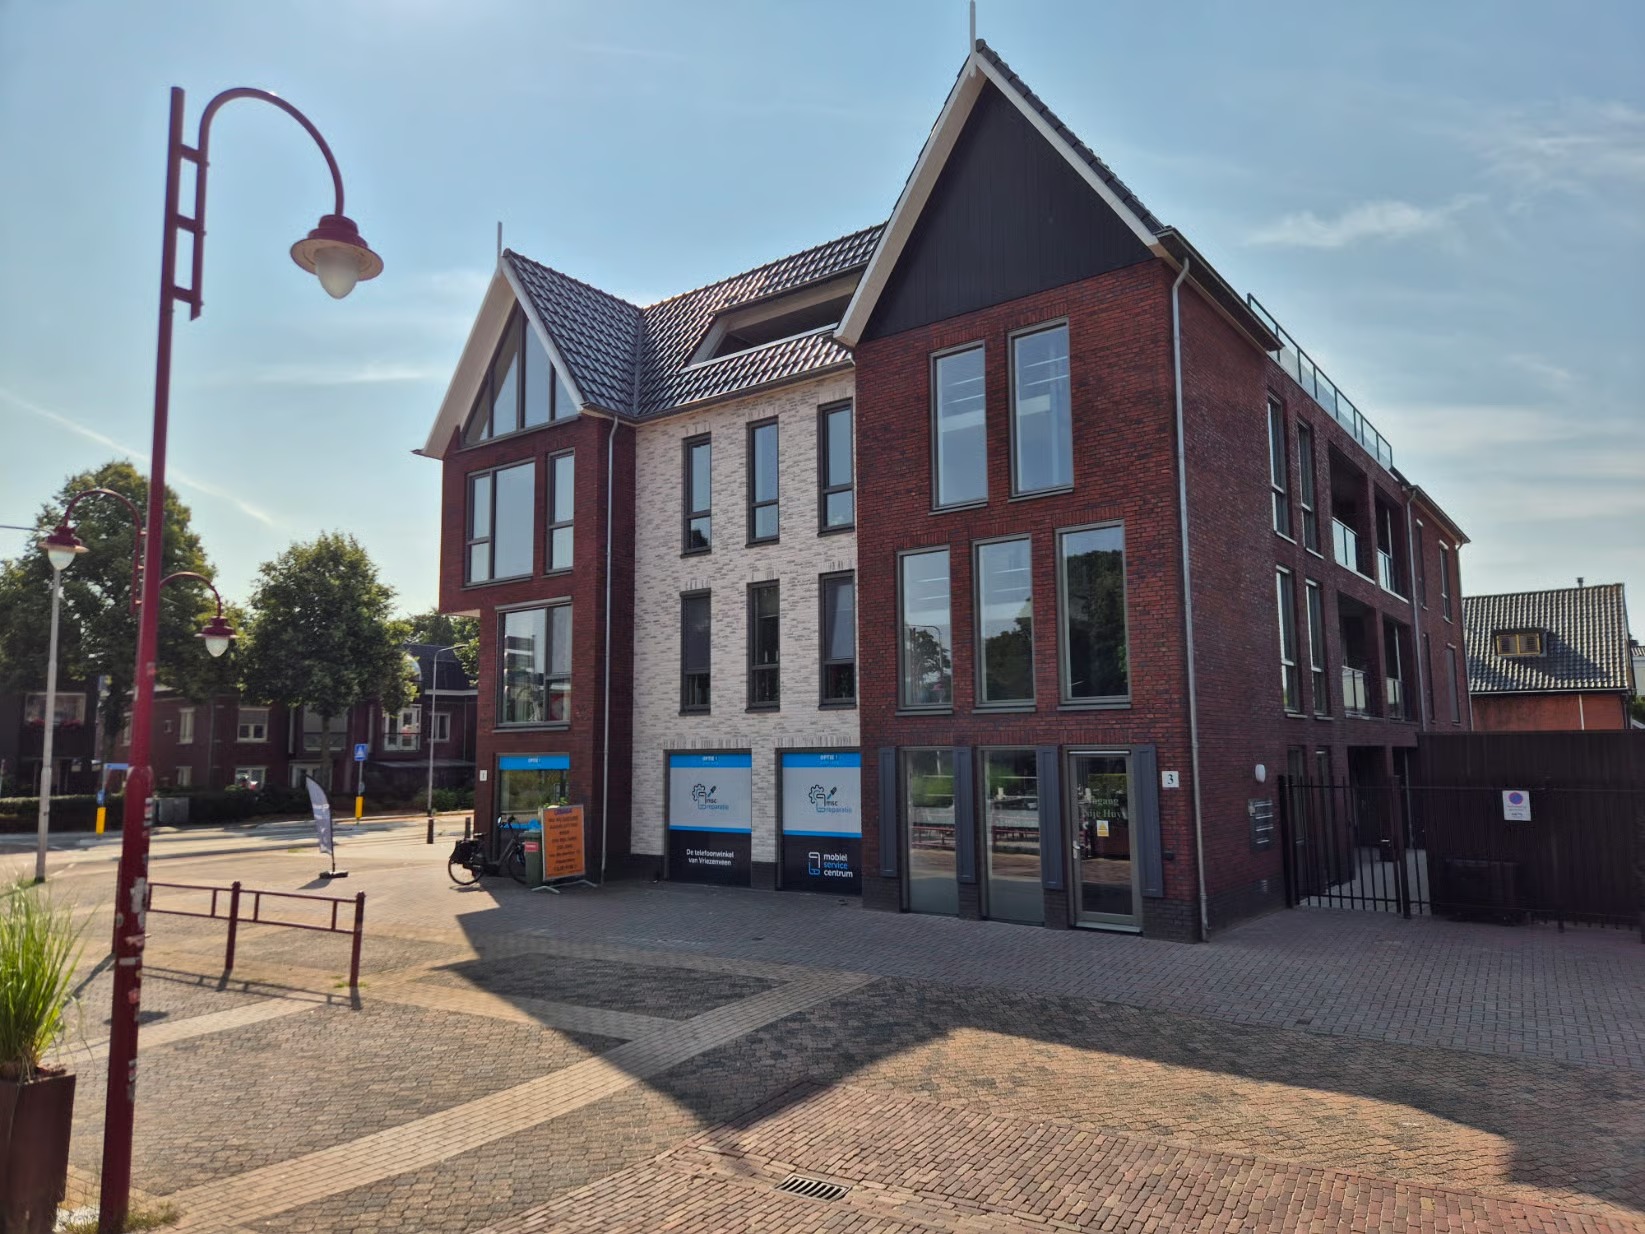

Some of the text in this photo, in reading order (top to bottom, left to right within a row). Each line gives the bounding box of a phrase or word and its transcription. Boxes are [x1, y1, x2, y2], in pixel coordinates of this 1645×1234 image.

[1168, 774, 1174, 784] 3
[1089, 798, 1119, 807] ngang
[686, 848, 734, 858] De telefoonwinkel
[823, 853, 848, 861] mobiel
[699, 857, 732, 866] Vriezenveen
[823, 861, 849, 869] service
[823, 869, 854, 878] centrum
